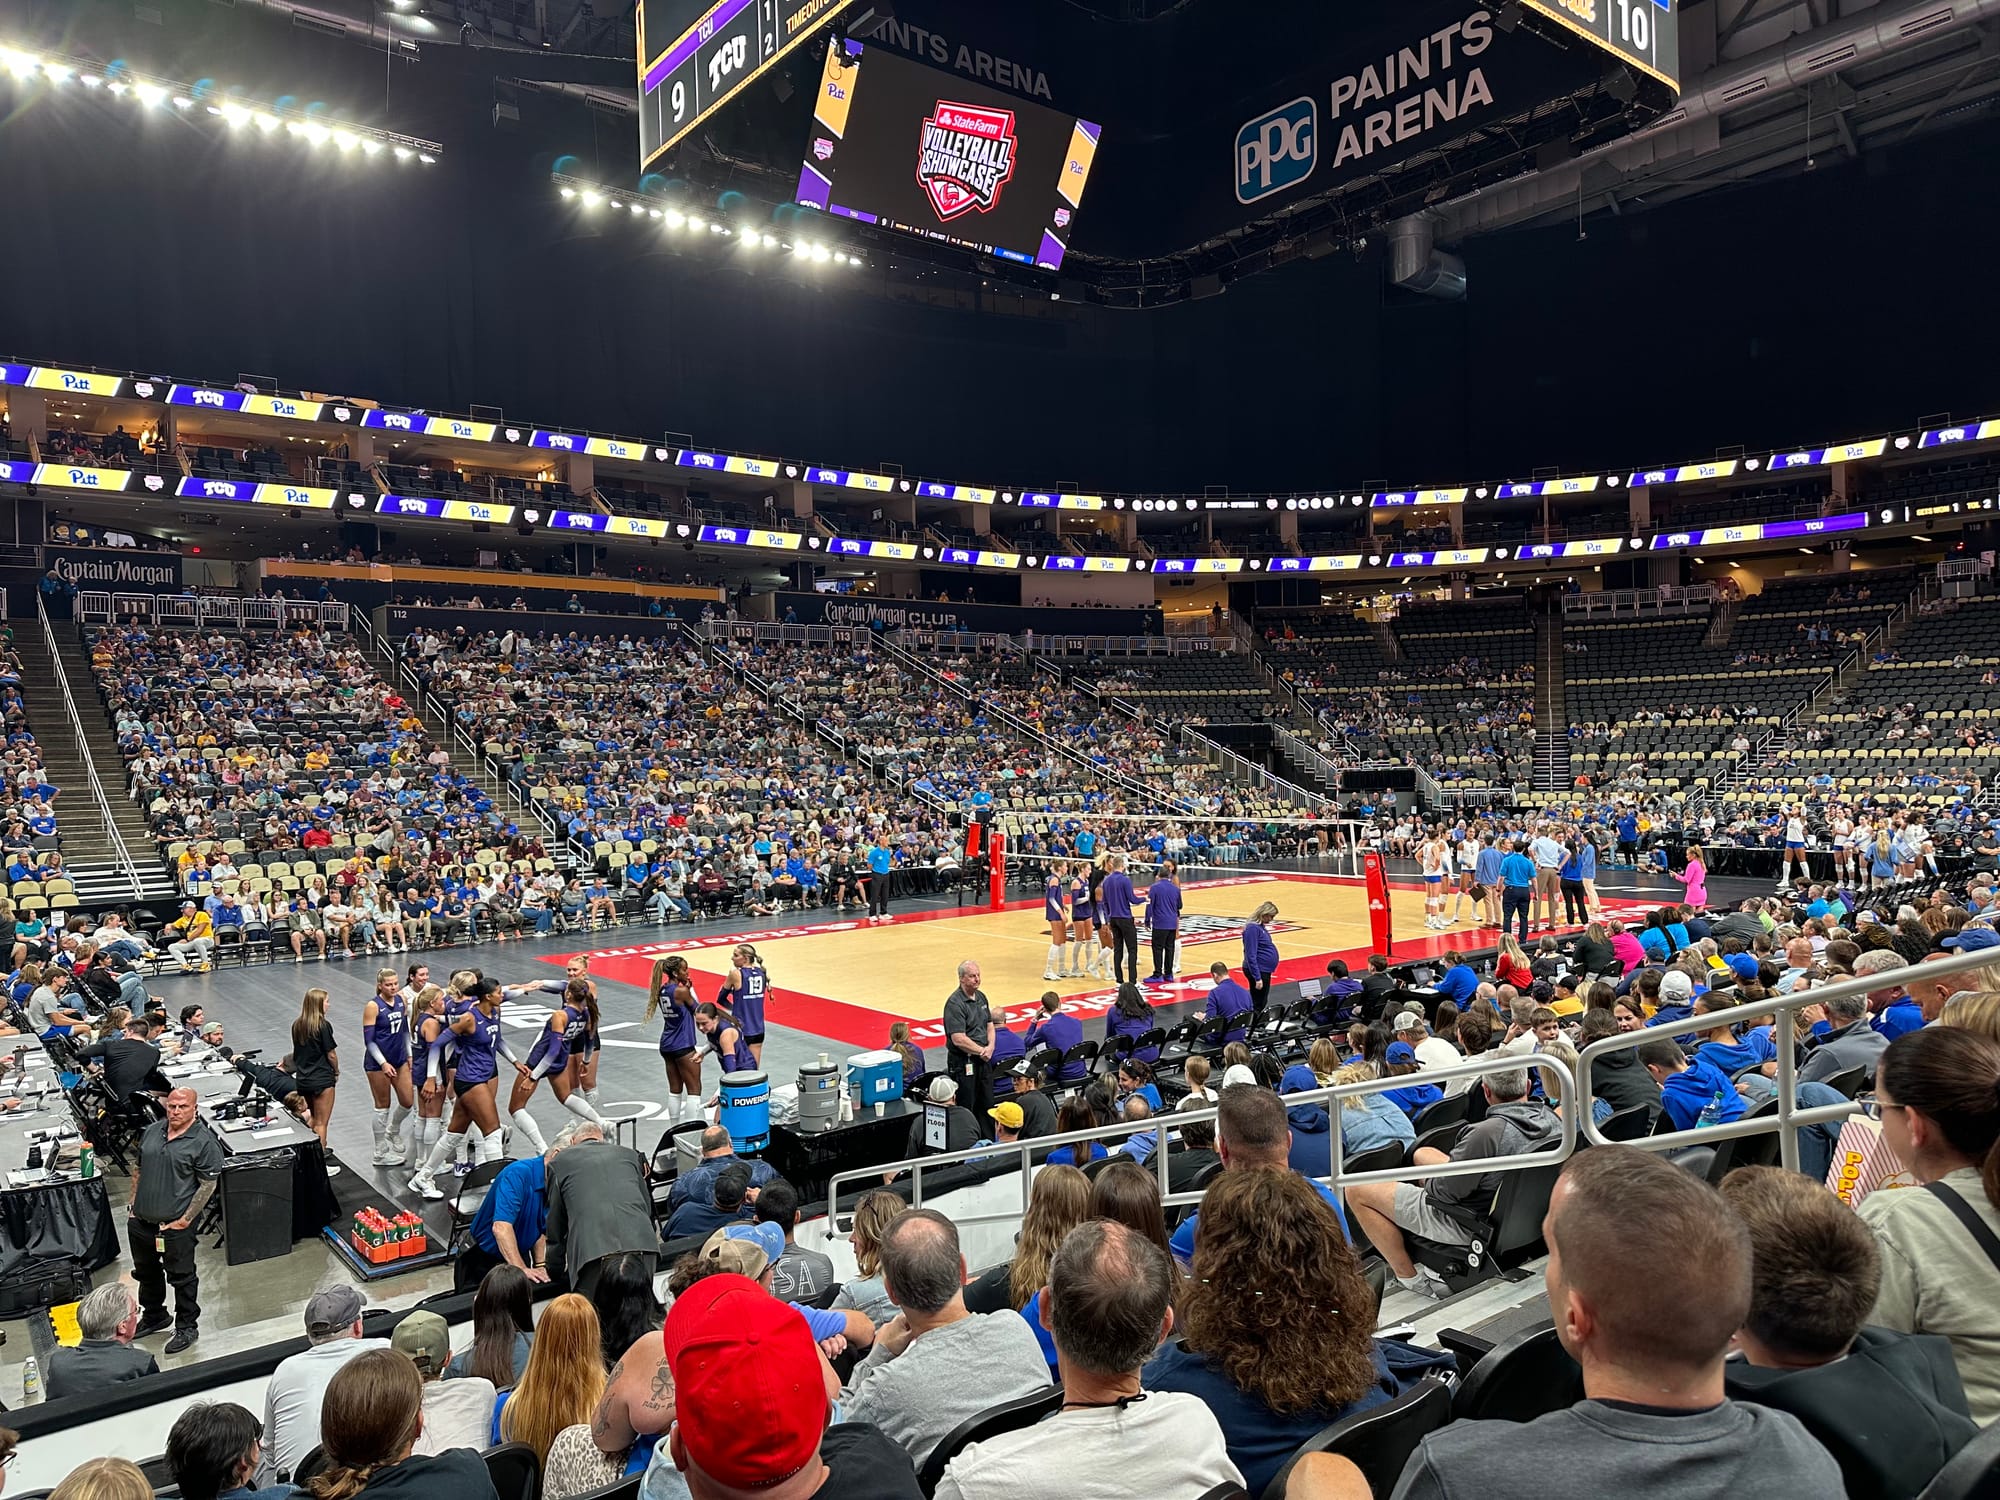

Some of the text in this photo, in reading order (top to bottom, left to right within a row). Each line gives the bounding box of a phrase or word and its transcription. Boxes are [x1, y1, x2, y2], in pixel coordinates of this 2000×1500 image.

[785, 0, 829, 35] TIMEOU
[698, 17, 713, 43] TCU
[1617, 0, 1648, 51] 10
[764, 33, 774, 56] 2
[708, 35, 747, 92] TCU
[1330, 10, 1494, 119] PAINTS
[954, 45, 1053, 101] ARENA
[827, 83, 846, 100] Pitt
[671, 81, 686, 123] 9
[1331, 67, 1495, 169] ARENA
[923, 126, 1008, 170] VOLLEYBALL
[1240, 115, 1312, 189] PPG
[922, 150, 996, 197] SHOWCASE
[1070, 160, 1083, 175] Pitt
[881, 217, 888, 226] 9
[984, 244, 993, 254] 10
[61, 374, 90, 390] Pitt
[192, 390, 225, 407] TCU
[271, 400, 296, 415] Pitt
[383, 414, 412, 429] TCU
[451, 422, 473, 437] Pitt
[1938, 429, 1965, 443] TCU
[548, 435, 573, 449] TCU
[608, 443, 627, 456] Pitt
[1846, 446, 1864, 457] Pitt
[692, 453, 714, 468] TCU
[1785, 453, 1811, 466] TCU
[744, 461, 761, 474] Pitt
[1698, 466, 1715, 477] Pitt
[68, 469, 99, 485] Pitt
[1643, 471, 1666, 484] TCU
[203, 481, 237, 498] TCU
[284, 488, 310, 504] Pitt
[398, 498, 428, 514] TCU
[1952, 502, 1959, 513] 1
[1983, 498, 1992, 510] 2
[468, 505, 490, 519] Pitt
[1880, 509, 1893, 523] 9
[567, 514, 593, 529] TCU
[629, 520, 648, 534] Pitt
[1805, 521, 1824, 531] TCU
[714, 528, 737, 542] TCU
[767, 533, 784, 546] Pitt
[1667, 533, 1690, 546] TCU
[1724, 529, 1742, 540] Pitt
[1829, 540, 1850, 551] 117
[54, 557, 174, 586] Captain Morgan
[1449, 571, 1467, 580] 116
[122, 601, 147, 614] 111
[291, 607, 313, 620] 111
[392, 610, 408, 619] 112
[825, 600, 866, 624] Captain
[866, 603, 906, 626] Morgan
[666, 622, 678, 630] 112
[735, 627, 753, 638] 113
[835, 631, 851, 642] 113
[919, 635, 934, 645] 114
[981, 637, 996, 647] 114
[1068, 639, 1083, 649] 115
[1194, 641, 1209, 650] 115
[387, 1011, 402, 1020] TCU
[390, 1020, 402, 1034] 17
[565, 1021, 587, 1040] 22
[490, 1035, 496, 1048] 1
[933, 1130, 939, 1140] 4
[86, 1151, 94, 1160] G
[372, 1238, 380, 1247] G
[402, 1231, 410, 1240] G
[770, 1257, 817, 1298] SA
